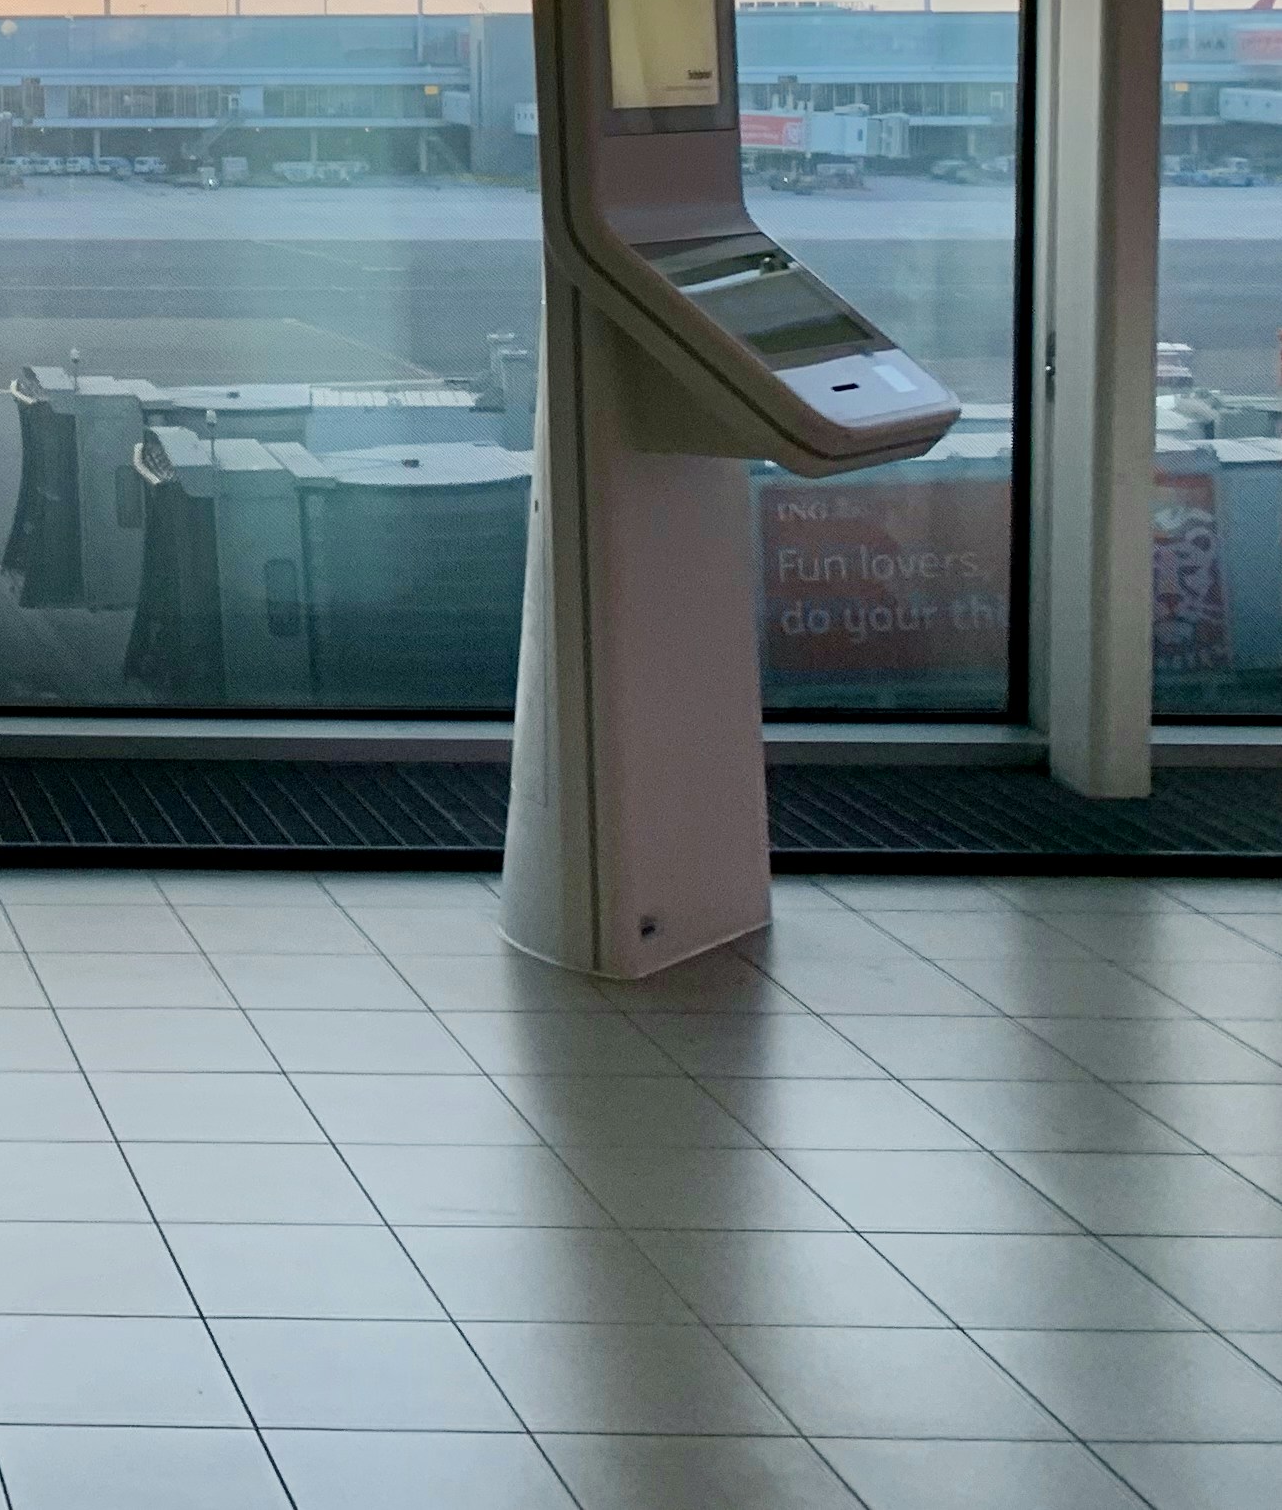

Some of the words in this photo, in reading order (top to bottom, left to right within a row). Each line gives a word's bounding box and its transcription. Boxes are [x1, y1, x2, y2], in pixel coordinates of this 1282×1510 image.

[778, 547, 847, 582] Fun
[782, 600, 831, 636] do
[843, 602, 939, 644] your
